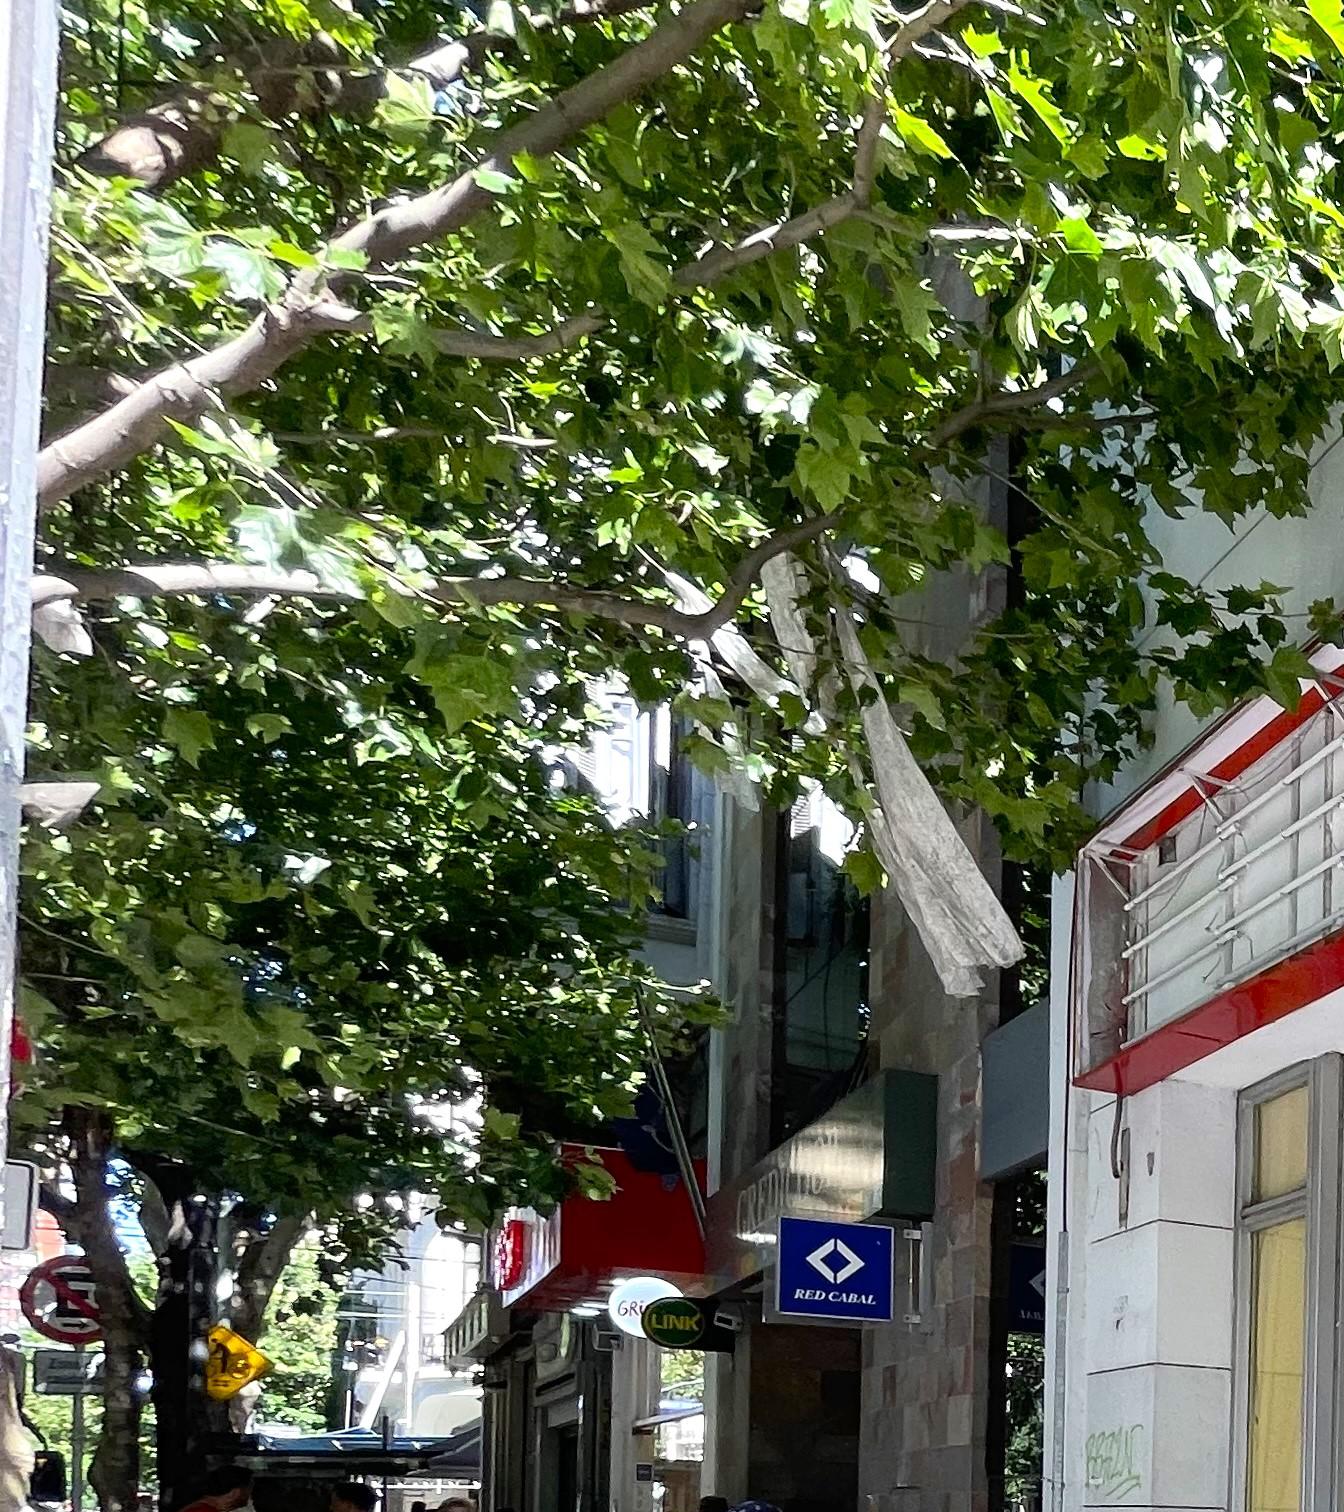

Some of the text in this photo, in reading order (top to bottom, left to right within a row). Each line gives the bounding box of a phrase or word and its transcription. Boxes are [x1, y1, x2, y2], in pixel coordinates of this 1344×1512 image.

[794, 1288, 877, 1305] RED CABAL
[651, 1311, 700, 1332] LINK
